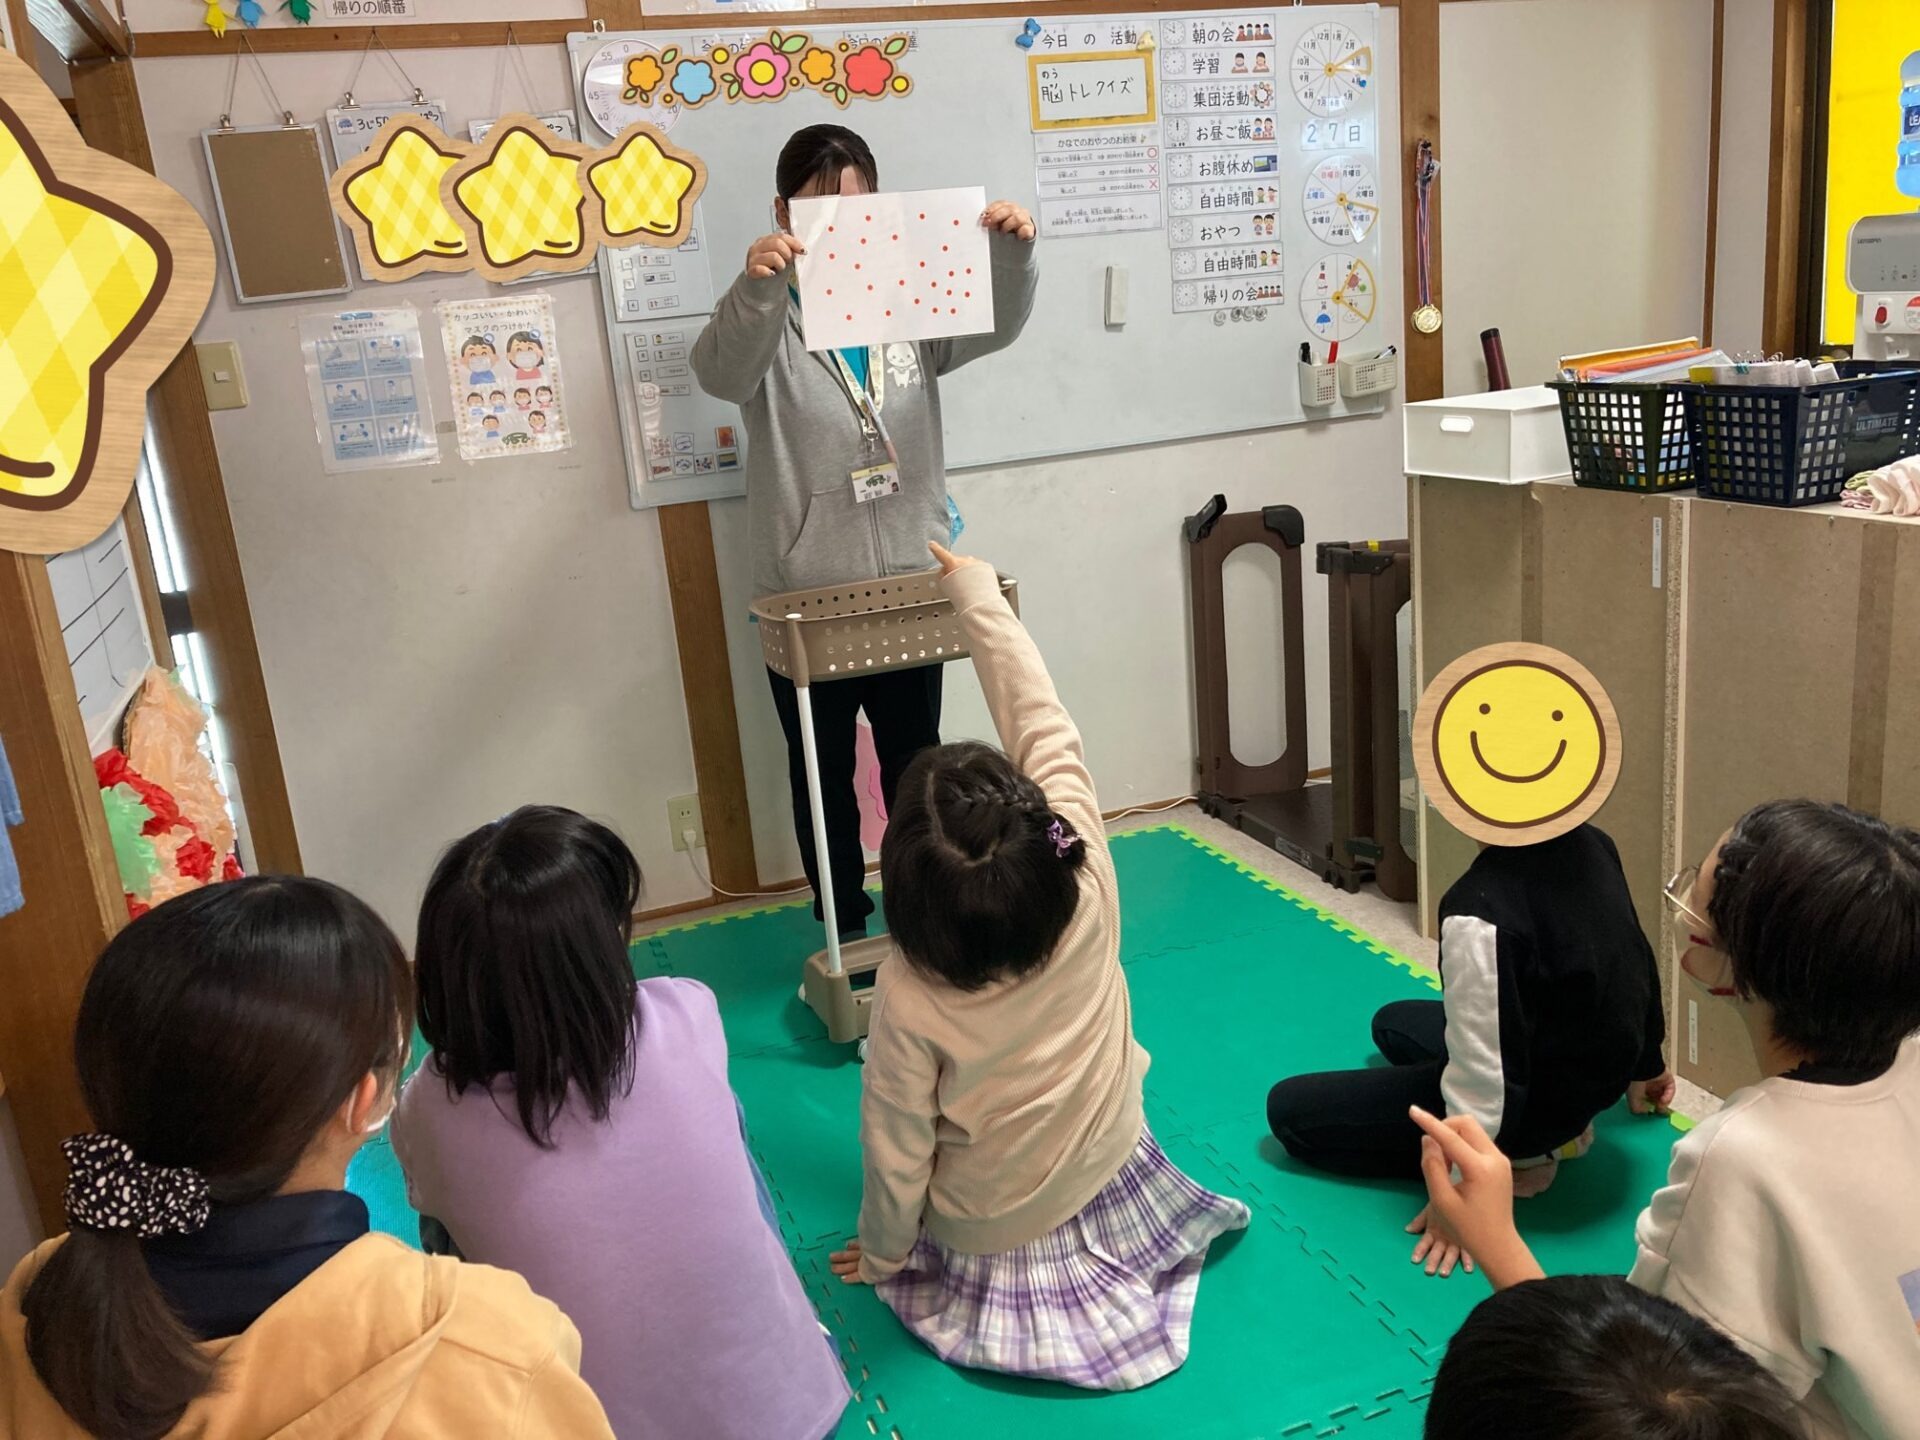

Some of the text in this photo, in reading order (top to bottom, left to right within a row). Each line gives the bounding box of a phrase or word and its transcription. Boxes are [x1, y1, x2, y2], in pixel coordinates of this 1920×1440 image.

[332, 0, 406, 15] 帰りの順番
[1042, 30, 1137, 48] 今日 の 活動
[1192, 27, 1234, 44] 朝の会
[1317, 32, 1329, 40] 12月
[1333, 32, 1342, 40] 1月
[623, 44, 629, 53] 0
[1304, 42, 1316, 50] 11月
[1346, 42, 1355, 50] 2月
[601, 52, 613, 61] 55
[1297, 57, 1310, 66] 10月
[1041, 68, 1058, 79] のう
[1193, 58, 1220, 74] 学習
[588, 91, 600, 100] 45
[1041, 76, 1134, 103] 脳トレクイズ
[1193, 90, 1250, 107] 集団活動
[598, 112, 609, 121] 40
[1909, 114, 1920, 127] LE
[1196, 124, 1252, 141] お昼ご飯
[1199, 159, 1254, 176] お腹休め
[1200, 190, 1254, 209] 自由時間
[1200, 225, 1241, 241] おやつ
[1204, 254, 1258, 272] 自由時間
[1204, 287, 1257, 305] 帰りの会
[1856, 416, 1899, 432] ULTIMATE
